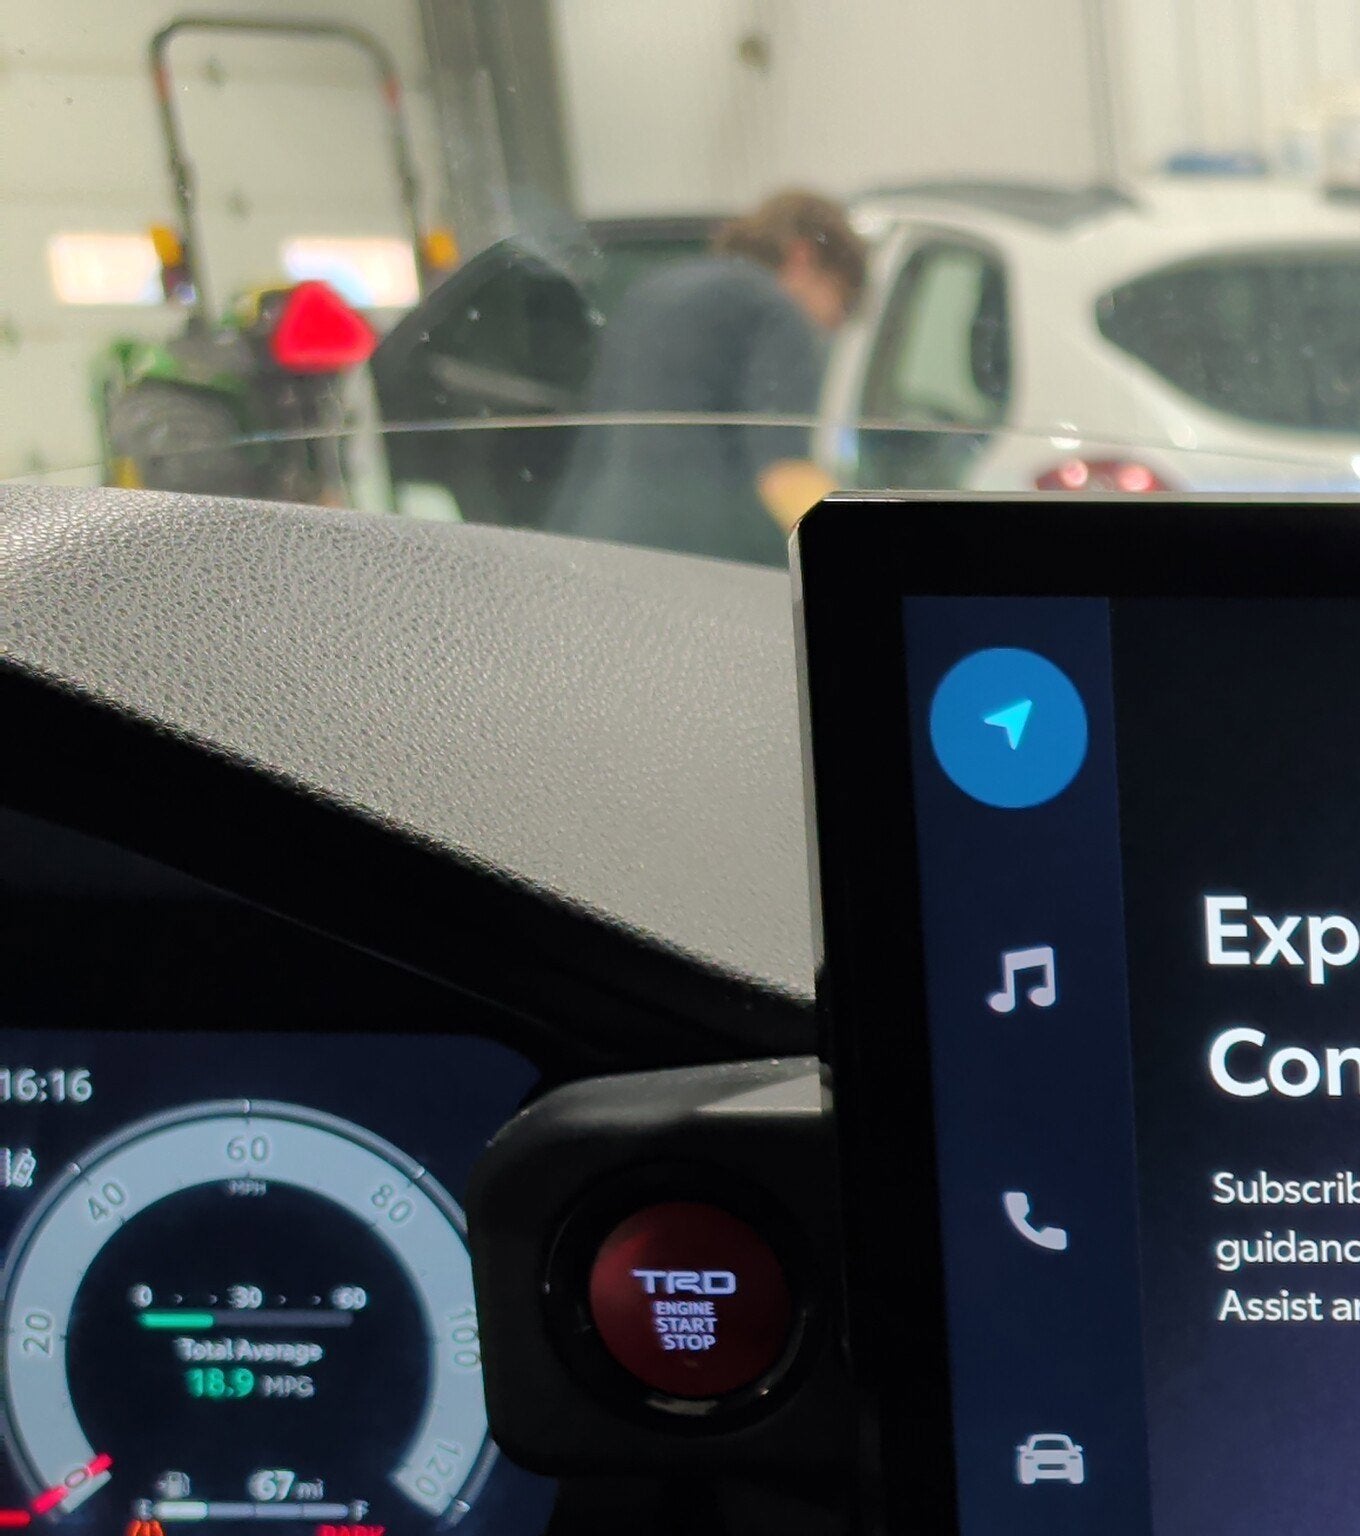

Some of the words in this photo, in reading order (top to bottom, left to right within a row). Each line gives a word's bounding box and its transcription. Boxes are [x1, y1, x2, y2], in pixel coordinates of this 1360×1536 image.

[0, 1068, 92, 1103] 16:16
[226, 1136, 269, 1162] 60
[87, 1182, 127, 1222] 40
[371, 1184, 411, 1223] 80
[631, 1269, 738, 1295] TRD
[654, 1300, 715, 1316] ENGINE
[1218, 1289, 1323, 1322] Assist
[23, 1312, 53, 1358] 20
[450, 1308, 481, 1369] 100
[655, 1317, 718, 1333] START
[174, 1337, 234, 1362] Total
[234, 1338, 323, 1367] Average
[662, 1334, 717, 1351] STOP
[187, 1368, 255, 1397] 18.9
[259, 1374, 316, 1397] MPG
[248, 1469, 295, 1500] 67
[415, 1442, 462, 1497] 120
